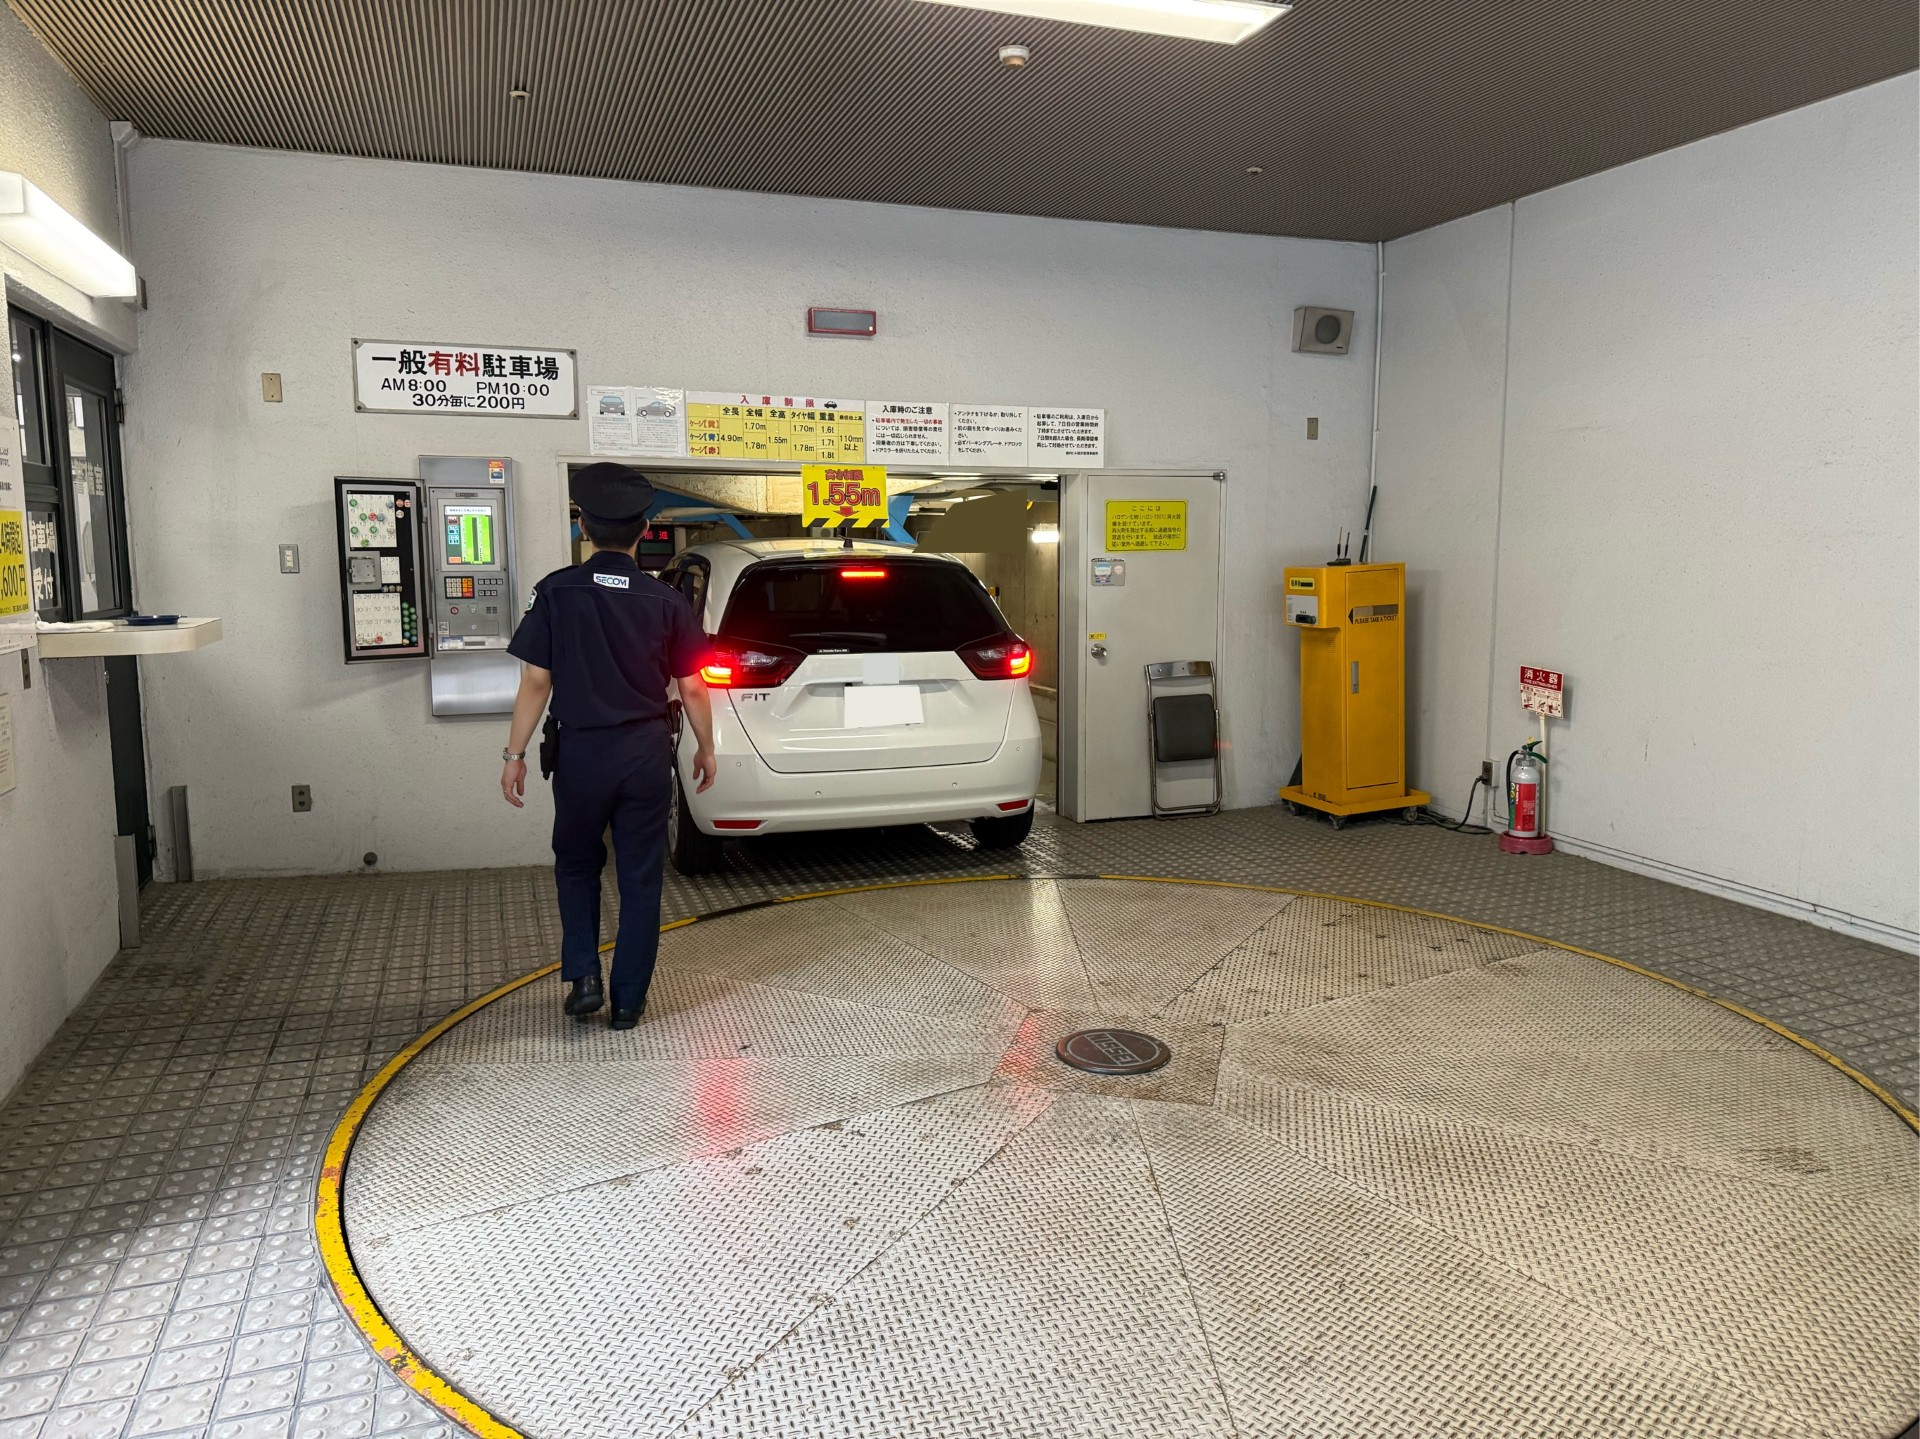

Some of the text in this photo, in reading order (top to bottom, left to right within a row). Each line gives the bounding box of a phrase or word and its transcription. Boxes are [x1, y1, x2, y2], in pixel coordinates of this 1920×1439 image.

[372, 349, 560, 380] 一般有料駐車場
[412, 394, 525, 410] 30分毎に200円
[740, 395, 815, 408] 入庫制限
[722, 406, 740, 416] 全長
[746, 408, 763, 417] 全幅
[770, 409, 786, 418] 全高
[790, 410, 815, 420] タイヤ幅
[819, 412, 836, 421] 重量
[882, 405, 933, 414] 入庫時のご注意
[744, 422, 766, 430] 1.70m
[794, 424, 814, 432] 1.70m
[720, 434, 743, 442] 4.90m
[745, 442, 766, 450] 1.78m
[794, 444, 814, 452] 1.78m
[807, 481, 881, 506] 1.55m
[596, 575, 627, 587] SECOM
[1524, 668, 1558, 684] 消火器
[741, 693, 771, 702] FIT
